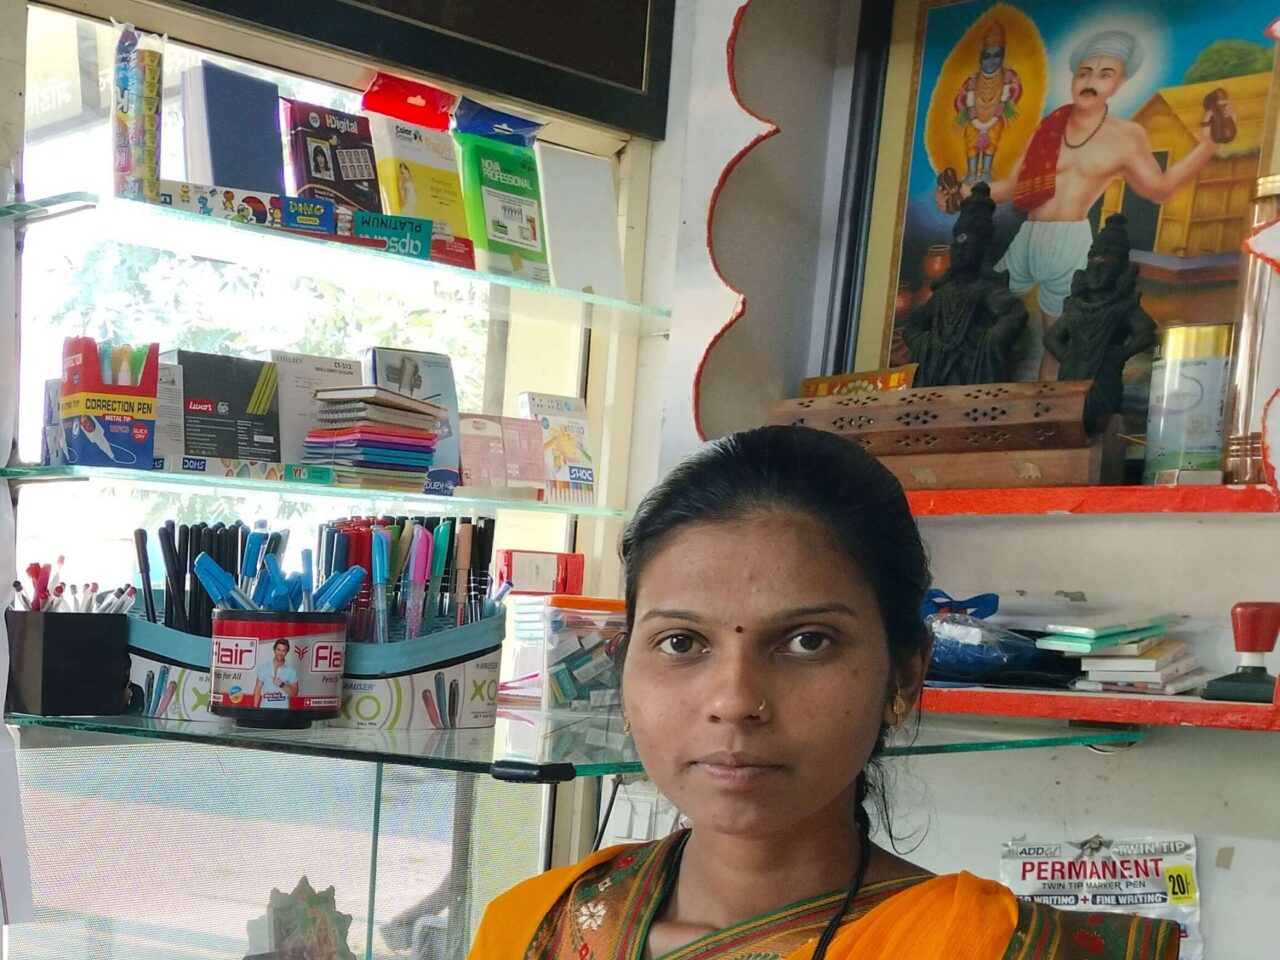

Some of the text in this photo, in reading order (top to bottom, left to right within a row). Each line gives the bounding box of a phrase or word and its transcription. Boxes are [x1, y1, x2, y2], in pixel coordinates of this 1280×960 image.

[481, 157, 500, 170] NOVA
[483, 169, 532, 190] PROFESSIONAL
[361, 215, 421, 233] PLATINUM
[85, 398, 135, 413] CORRECTION
[137, 402, 152, 414] PEN
[232, 672, 242, 680] All
[1119, 841, 1187, 856] TWIN TIP
[1021, 858, 1163, 881] PERMANENT
[1042, 880, 1146, 891] TWIN TIP MARKER PEN
[1036, 895, 1076, 905] WRITING
[1096, 895, 1116, 904] FINE
[1118, 893, 1162, 904] WRITING
